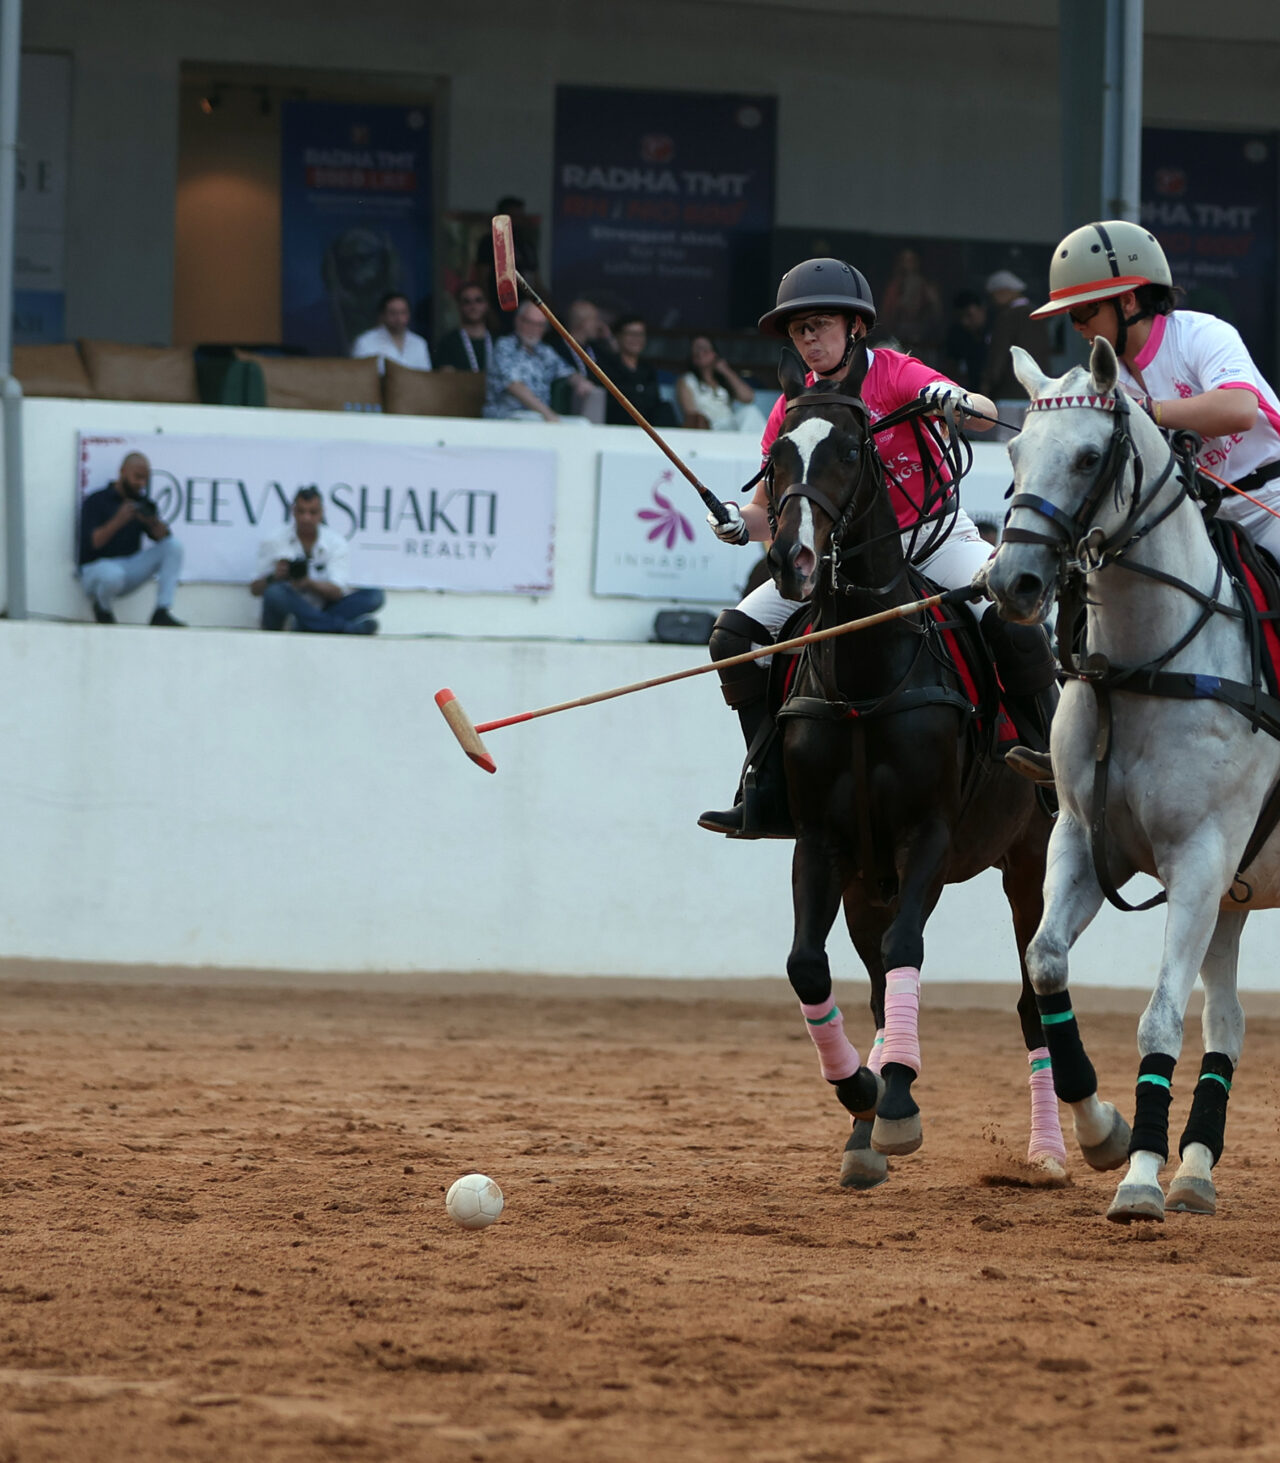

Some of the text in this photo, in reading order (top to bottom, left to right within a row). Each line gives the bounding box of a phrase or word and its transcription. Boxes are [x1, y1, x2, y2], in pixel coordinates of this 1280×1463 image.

[562, 164, 750, 197] RADHA TMT
[1194, 204, 1257, 230] TMT
[147, 469, 499, 542] DEEVYSHAKTI
[405, 538, 497, 560] REALTY
[614, 553, 712, 570] INHABIT
